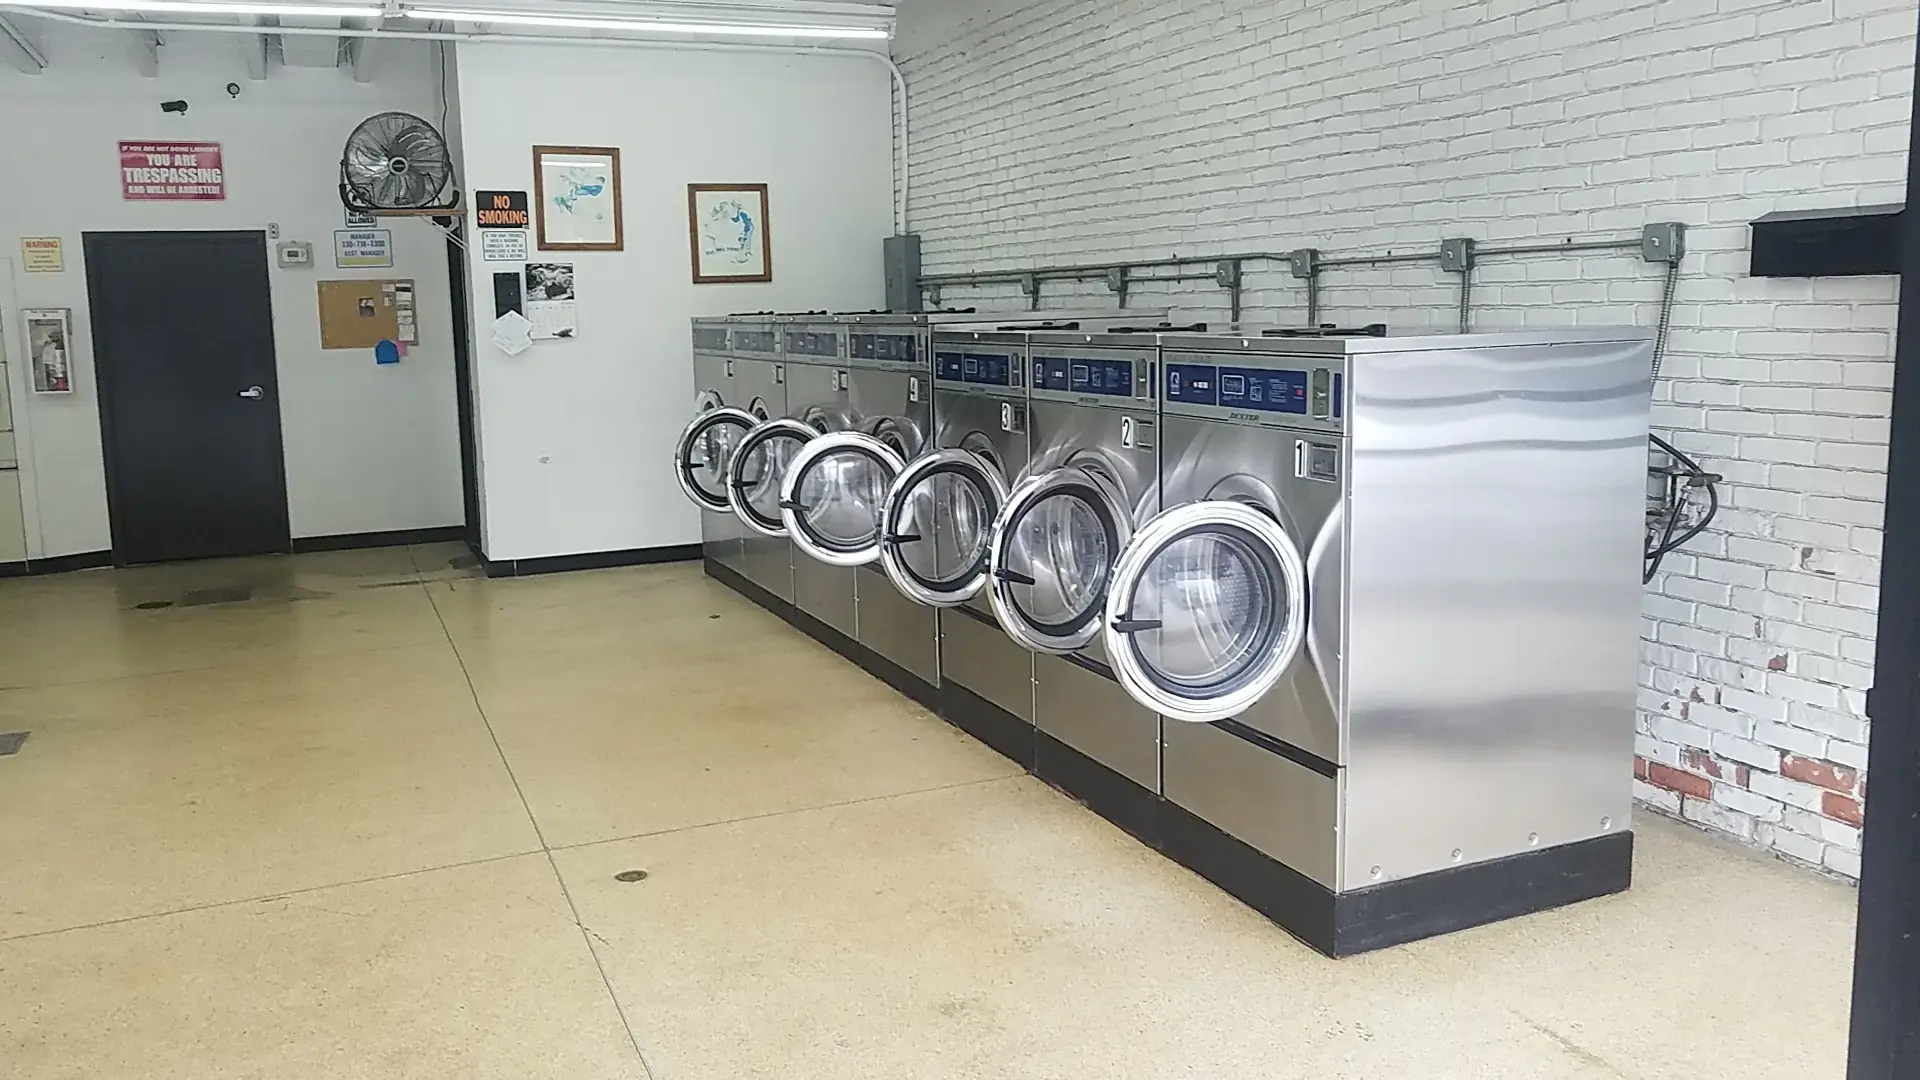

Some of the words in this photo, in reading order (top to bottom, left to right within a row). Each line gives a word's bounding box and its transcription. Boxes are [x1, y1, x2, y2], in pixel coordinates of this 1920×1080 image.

[146, 154, 170, 167] YOU
[174, 154, 197, 167] ARE
[123, 167, 222, 184] TRESPASSING
[128, 185, 145, 194] AND
[146, 185, 166, 194] WILL
[167, 185, 177, 194] BE
[493, 195, 511, 209] NO
[478, 210, 528, 224] SMOKING
[1002, 404, 1009, 428] 3
[1228, 412, 1260, 422] DEXTER
[1122, 418, 1130, 446] 2
[1296, 441, 1303, 476] 1
